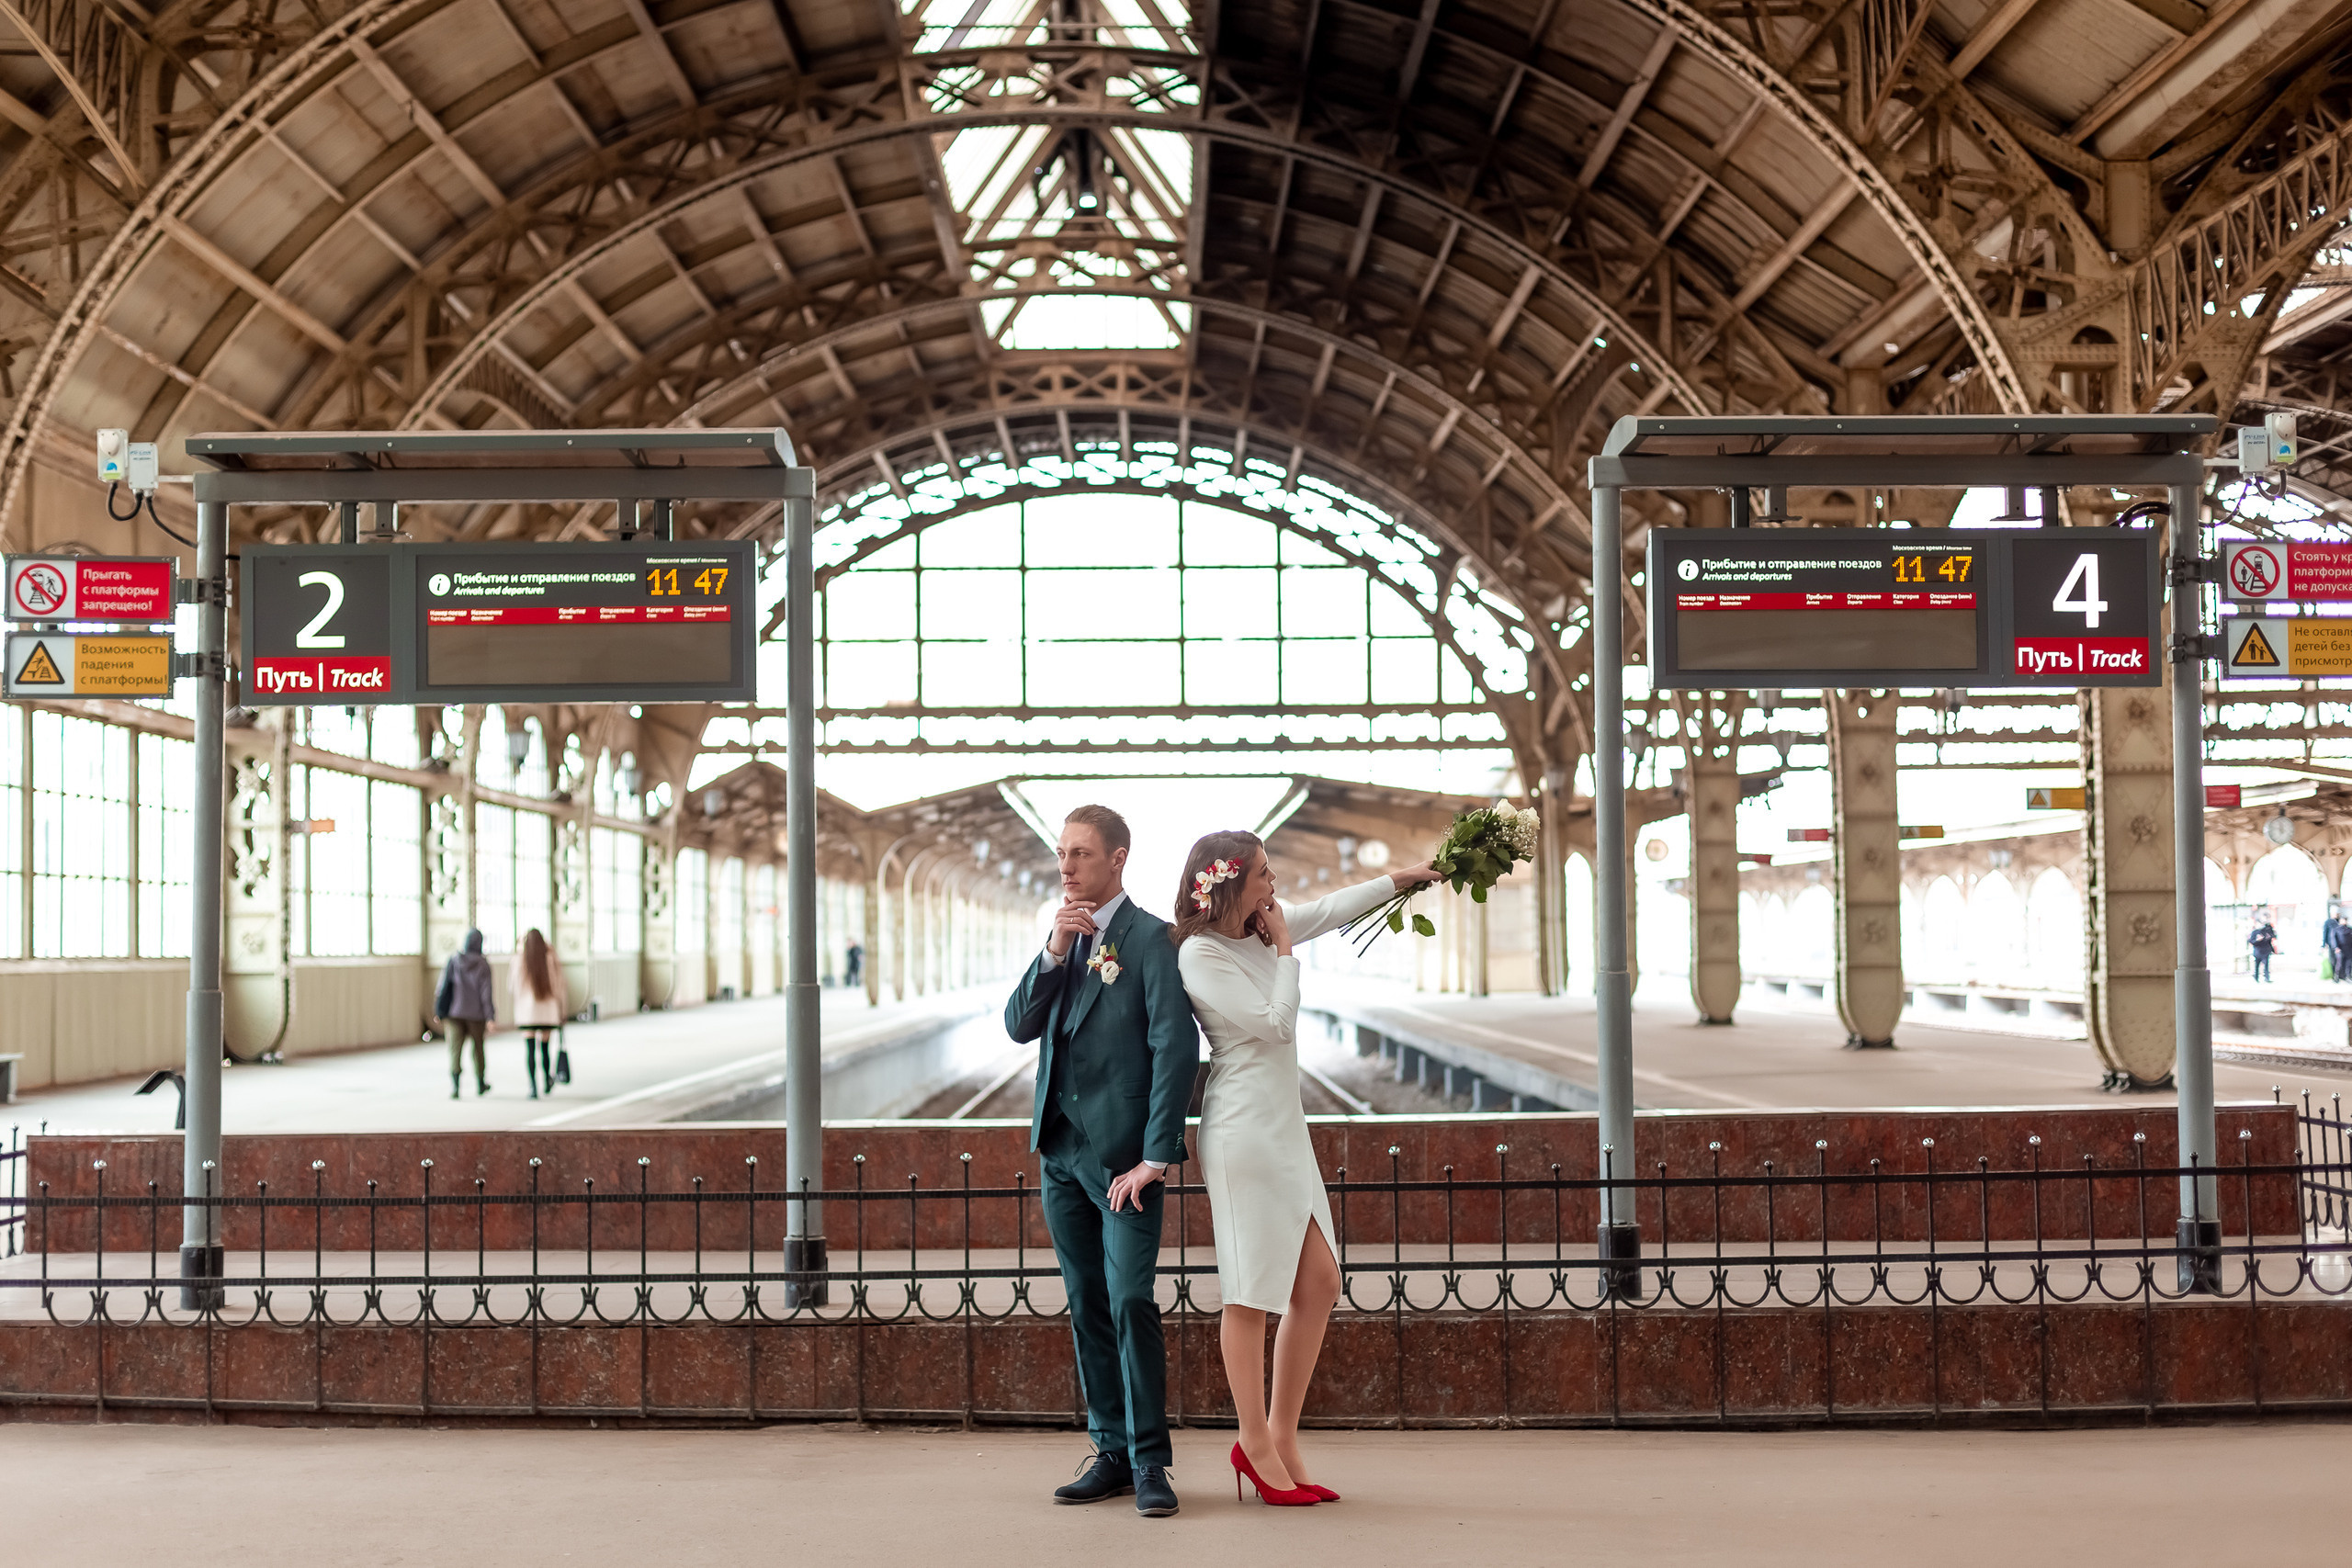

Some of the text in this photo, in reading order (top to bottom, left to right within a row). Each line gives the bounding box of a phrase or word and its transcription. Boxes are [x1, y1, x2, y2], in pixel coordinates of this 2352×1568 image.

[2293, 551, 2331, 561] Стоять
[2333, 553, 2339, 564] у
[1702, 558, 1883, 571] Прибытие и отправление поездов
[1892, 556, 1973, 582] 11 47
[83, 569, 132, 582] Прыгать
[454, 572, 636, 586] Прибытие и отправление поездов
[1702, 571, 1792, 581] Arrivals and departures
[2294, 567, 2352, 579] платформ
[647, 568, 729, 595] 11 47
[2294, 583, 2308, 592] не
[82, 584, 159, 598] с платформы
[484, 586, 502, 595] and
[502, 585, 545, 596] departures
[2052, 553, 2109, 628] 4
[82, 600, 153, 613] запрещено!
[296, 570, 345, 649] 2
[2294, 626, 2352, 637] Не оставл
[81, 644, 166, 654] Возможность
[2294, 640, 2351, 652] детей без
[2018, 647, 2143, 671] Путь Track
[2295, 658, 2352, 668] присмотр
[81, 661, 134, 671] падения
[80, 675, 167, 687] с платформы!
[256, 667, 384, 693] Путь Track
